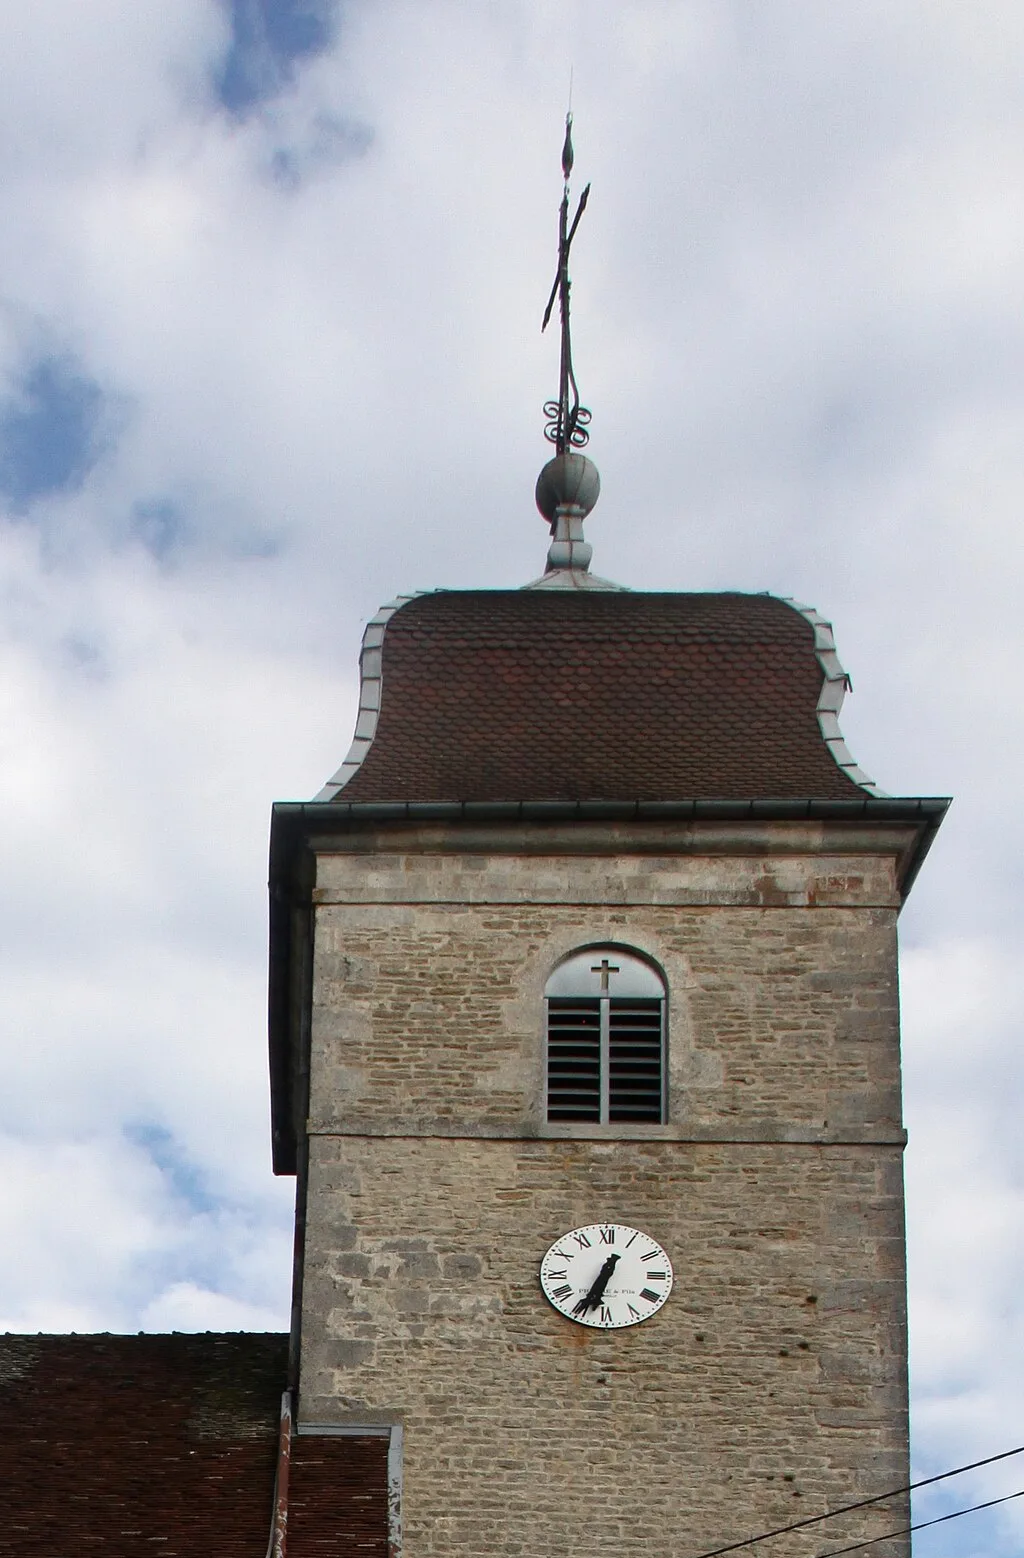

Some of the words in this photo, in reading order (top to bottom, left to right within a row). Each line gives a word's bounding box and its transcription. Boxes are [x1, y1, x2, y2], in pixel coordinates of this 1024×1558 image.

[573, 1233, 592, 1250] XI
[599, 1229, 615, 1245] XII
[554, 1249, 574, 1262] X
[640, 1250, 659, 1262] II
[548, 1269, 567, 1280] IX
[646, 1271, 666, 1280] III
[627, 1303, 640, 1319] V
